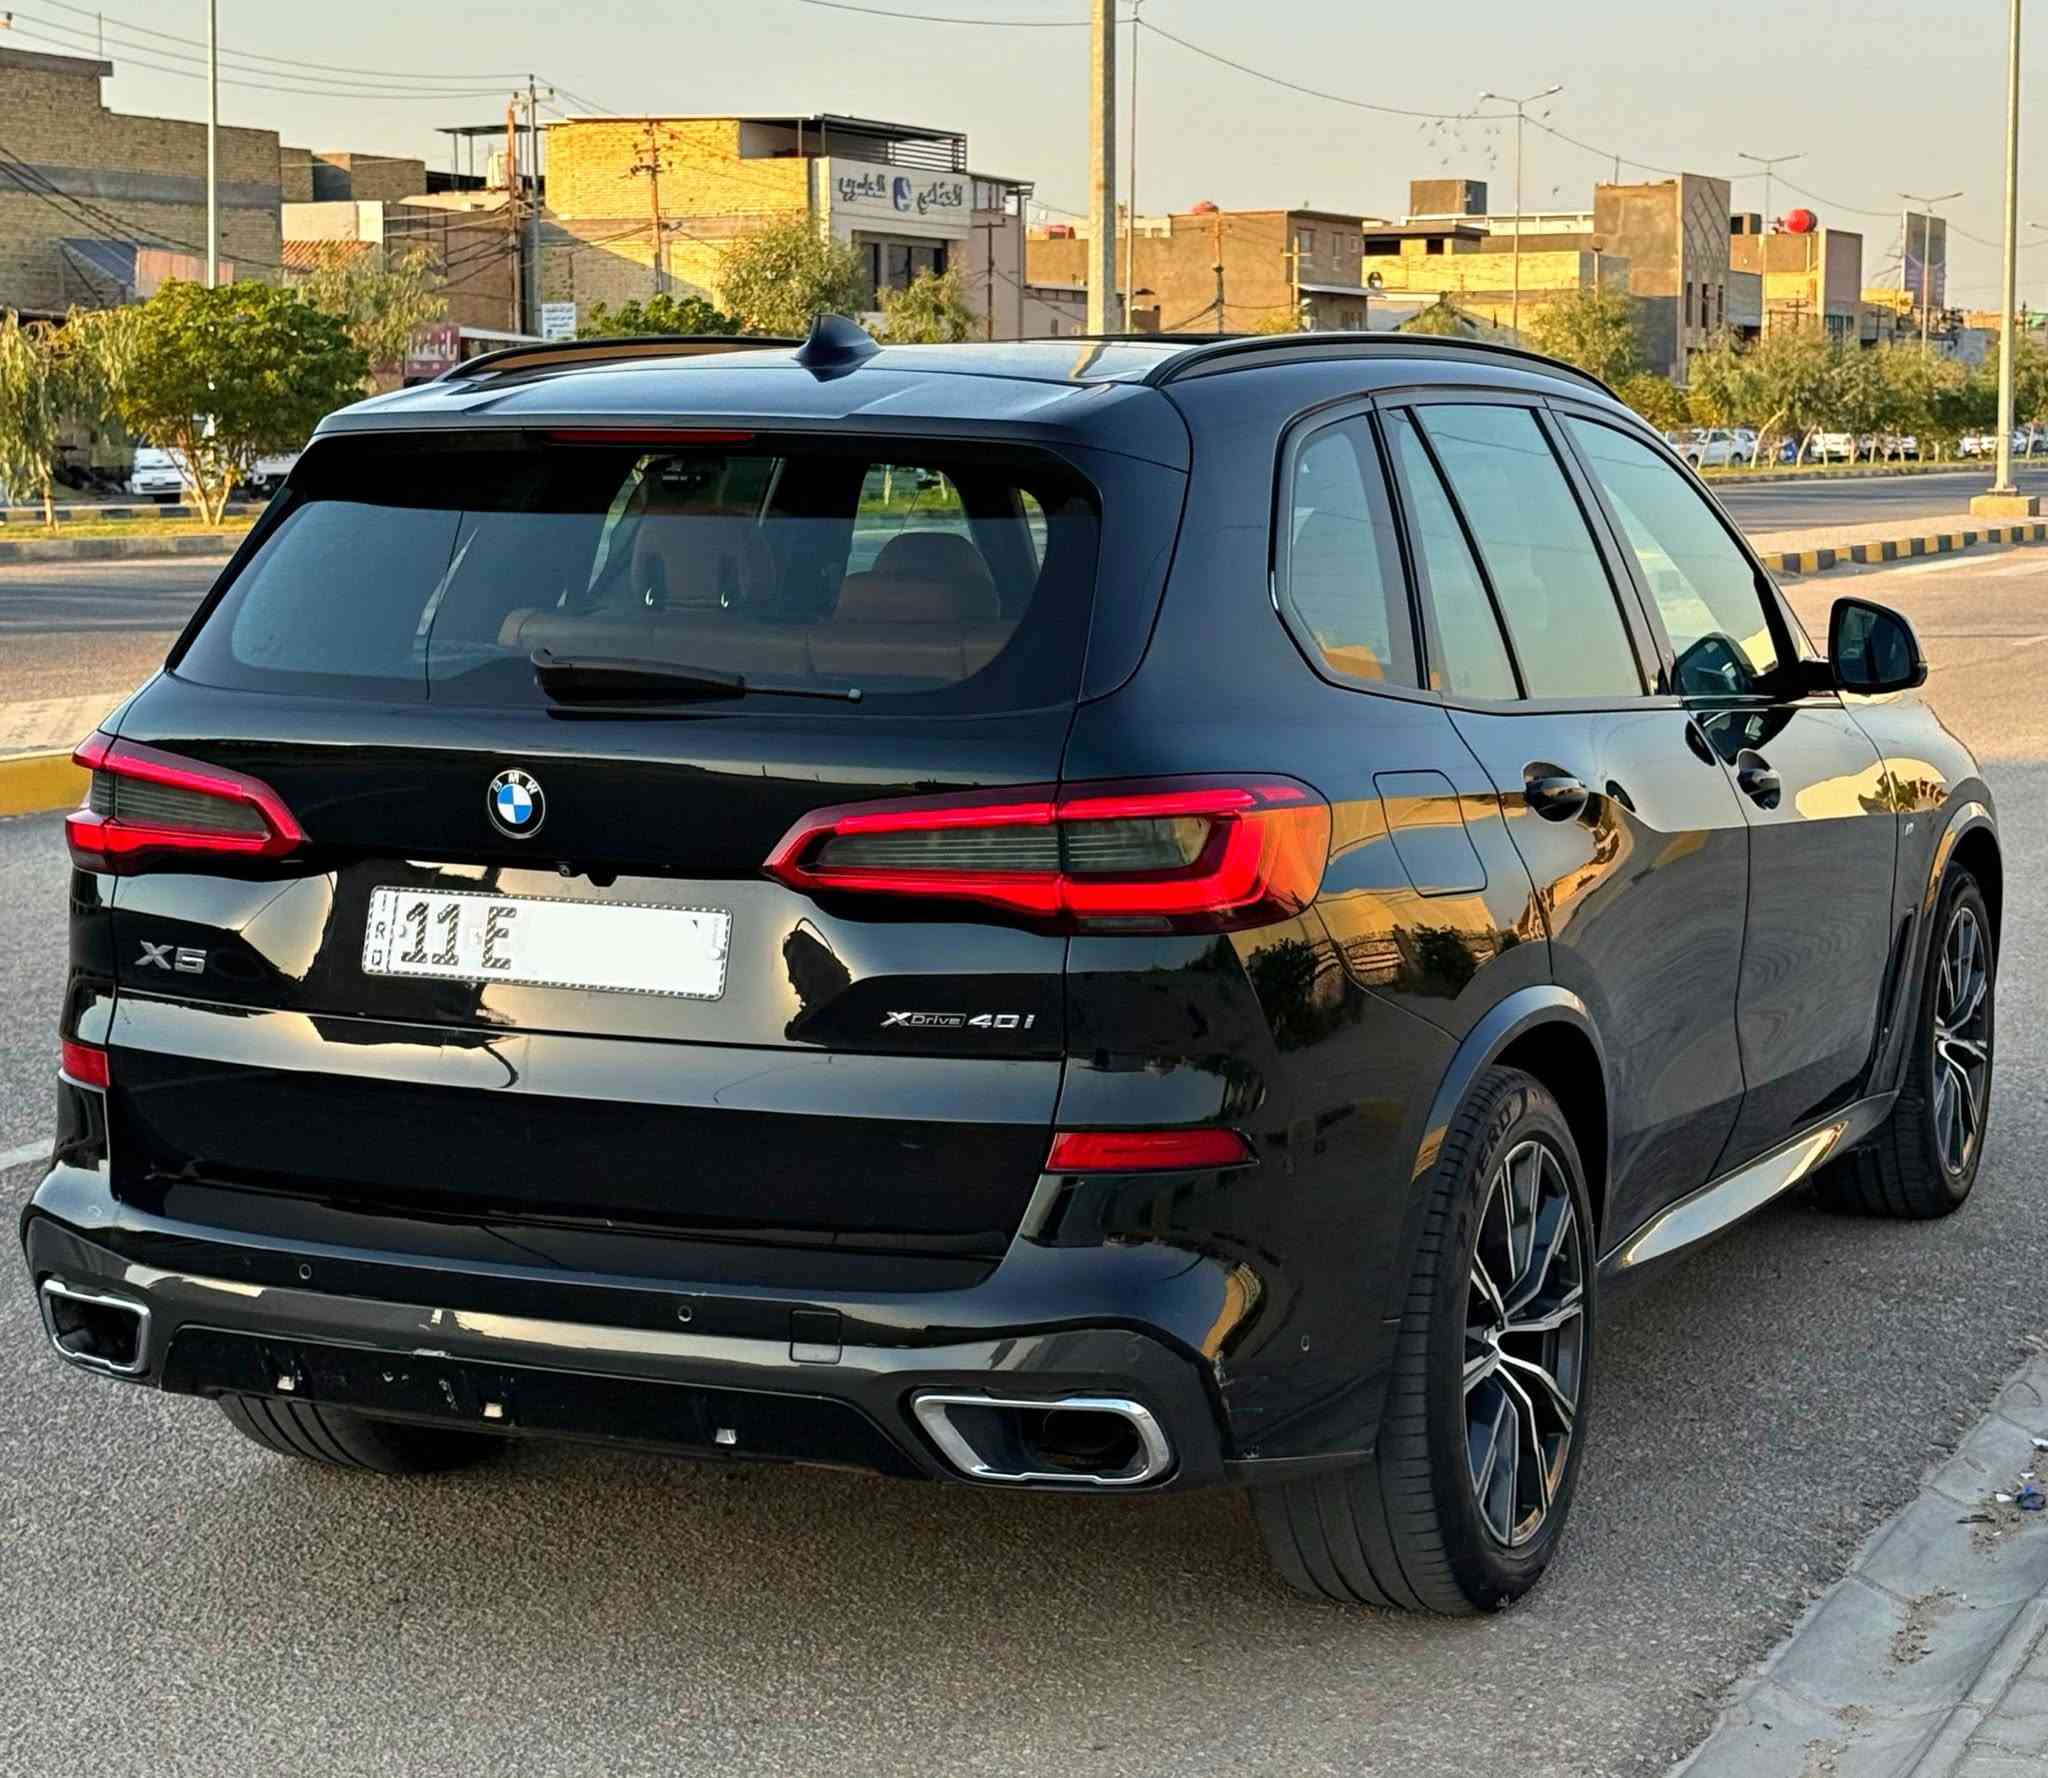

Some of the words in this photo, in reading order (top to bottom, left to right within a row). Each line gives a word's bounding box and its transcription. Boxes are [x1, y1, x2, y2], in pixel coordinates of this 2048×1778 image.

[492, 771, 540, 795] BMW
[400, 901, 461, 966] 11
[481, 905, 518, 970] E
[134, 939, 207, 975] X5
